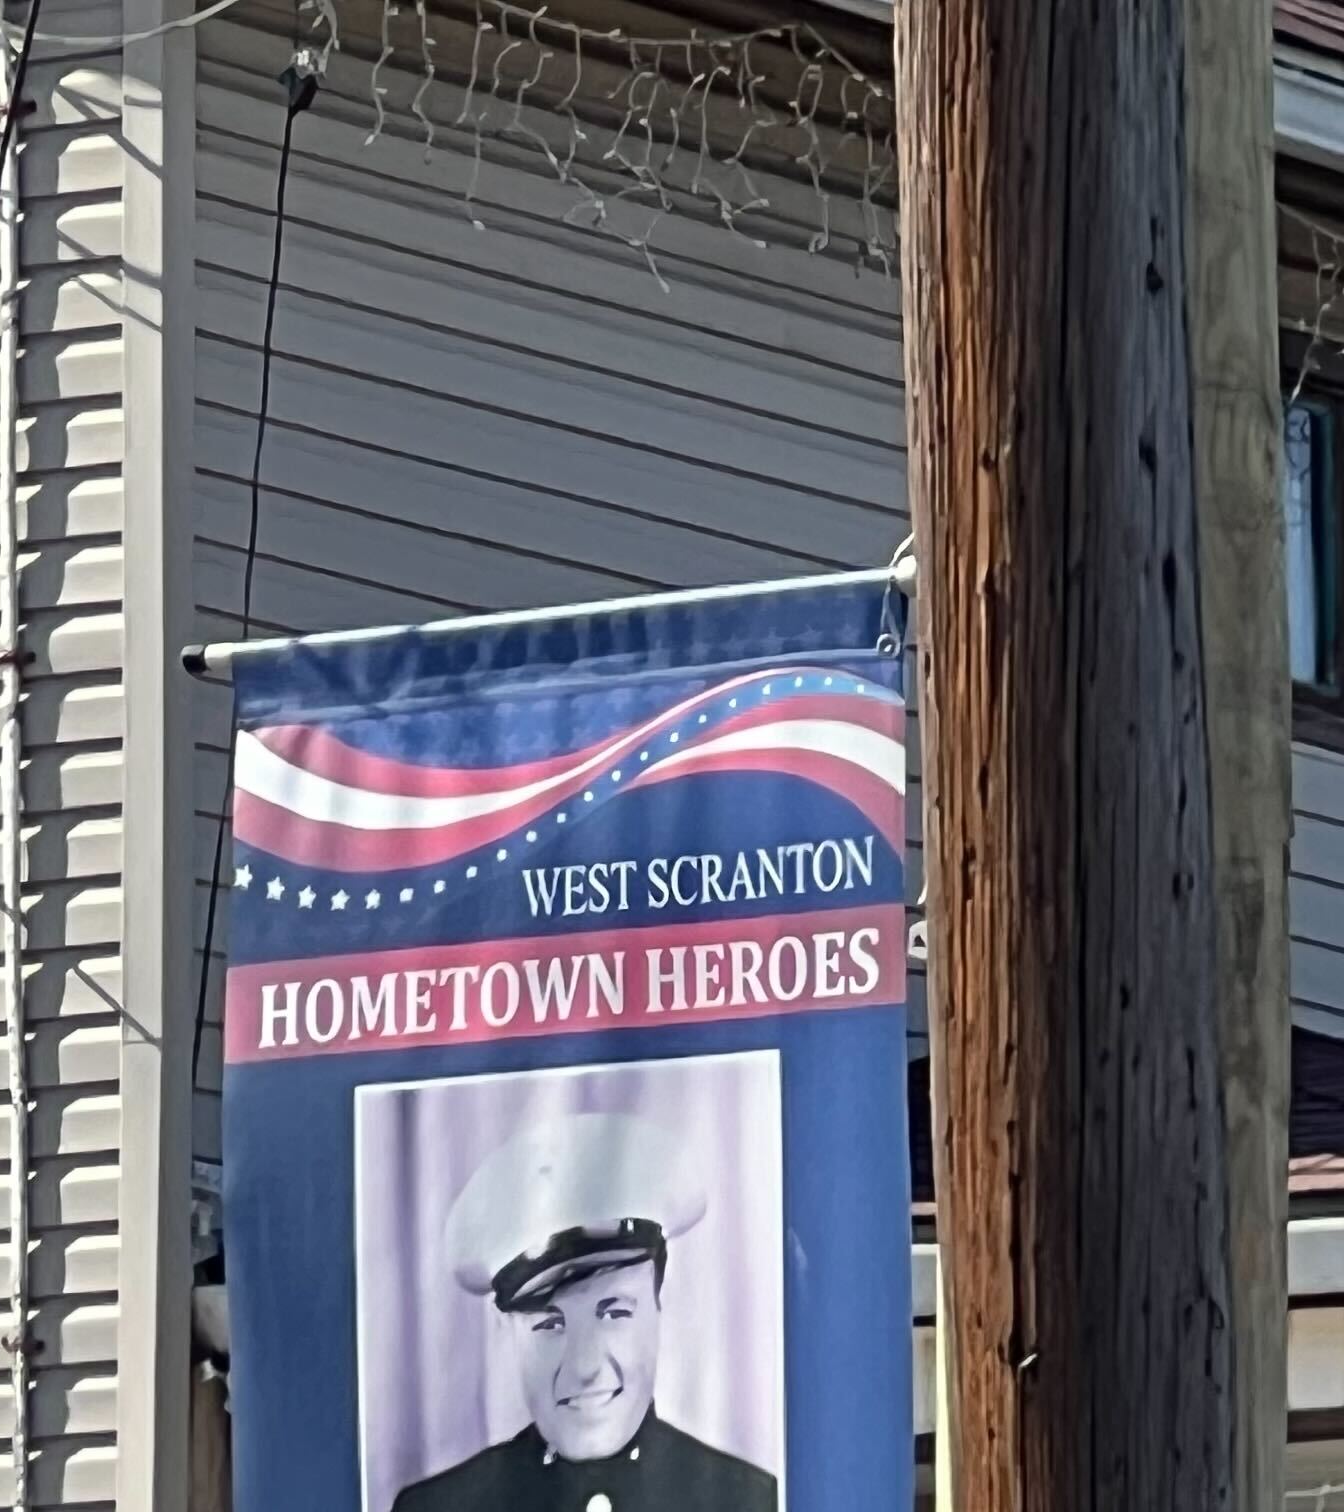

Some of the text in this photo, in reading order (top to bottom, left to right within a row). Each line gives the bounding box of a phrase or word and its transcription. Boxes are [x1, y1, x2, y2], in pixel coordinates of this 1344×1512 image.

[523, 836, 875, 916] WEST SCRANTON
[259, 928, 880, 1049] HOMETOWN HEROES
